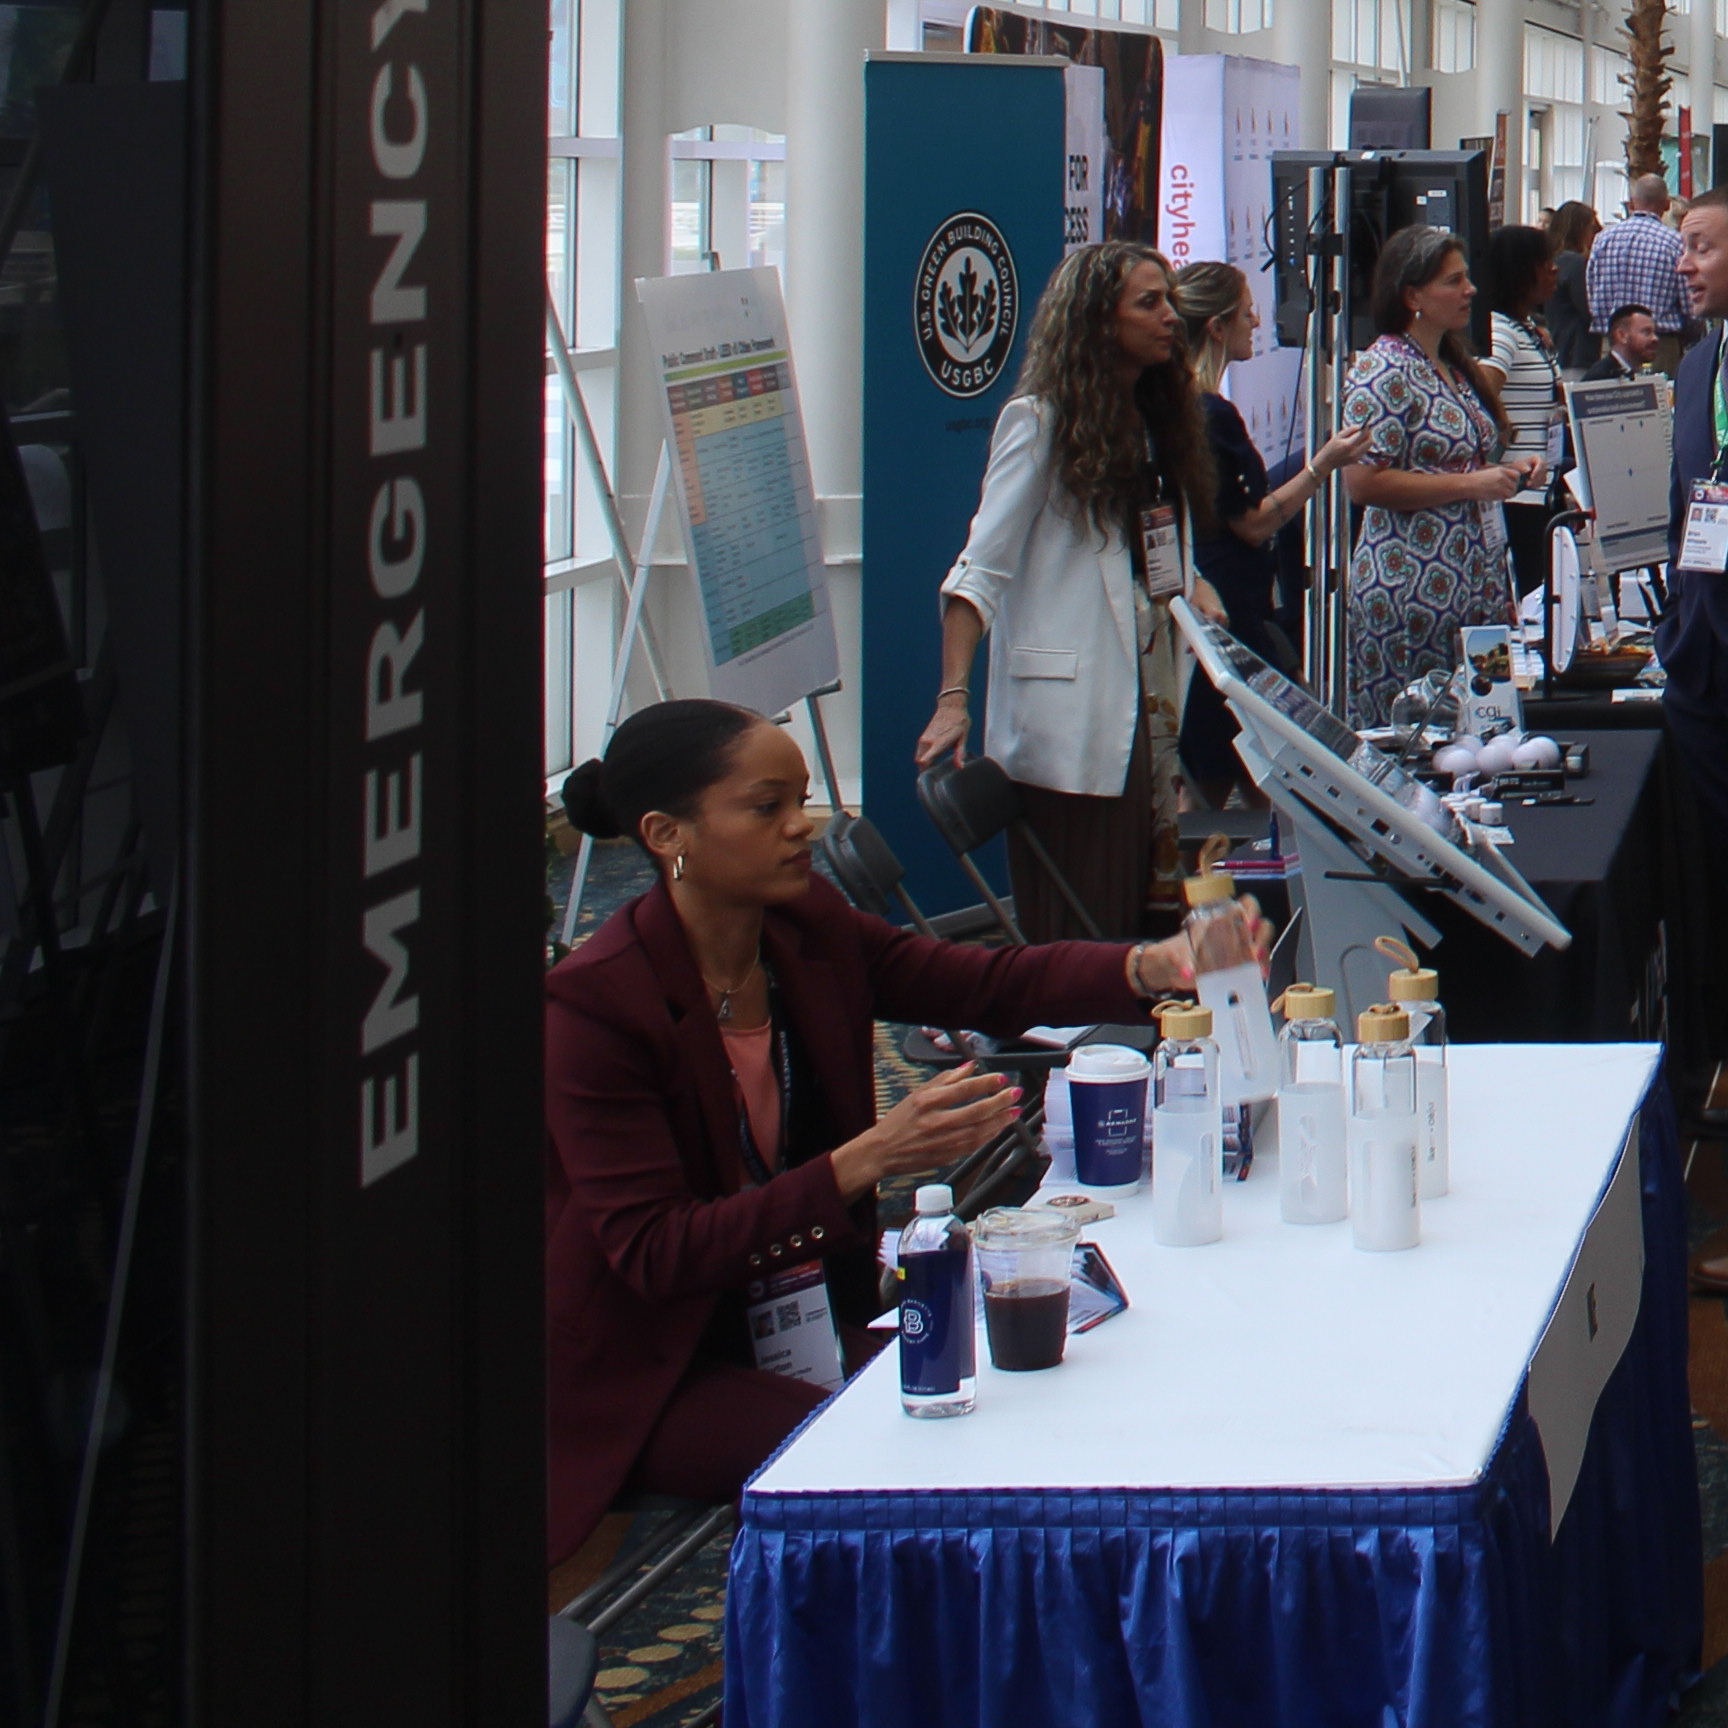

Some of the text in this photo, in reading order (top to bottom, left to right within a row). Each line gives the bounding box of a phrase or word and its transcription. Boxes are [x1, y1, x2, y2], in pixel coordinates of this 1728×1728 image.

[1068, 154, 1089, 191] FOR
[921, 239, 949, 300] GREEN
[947, 225, 999, 256] BUILDING
[997, 255, 1012, 336] COUNCIL
[941, 358, 995, 388] USGBC
